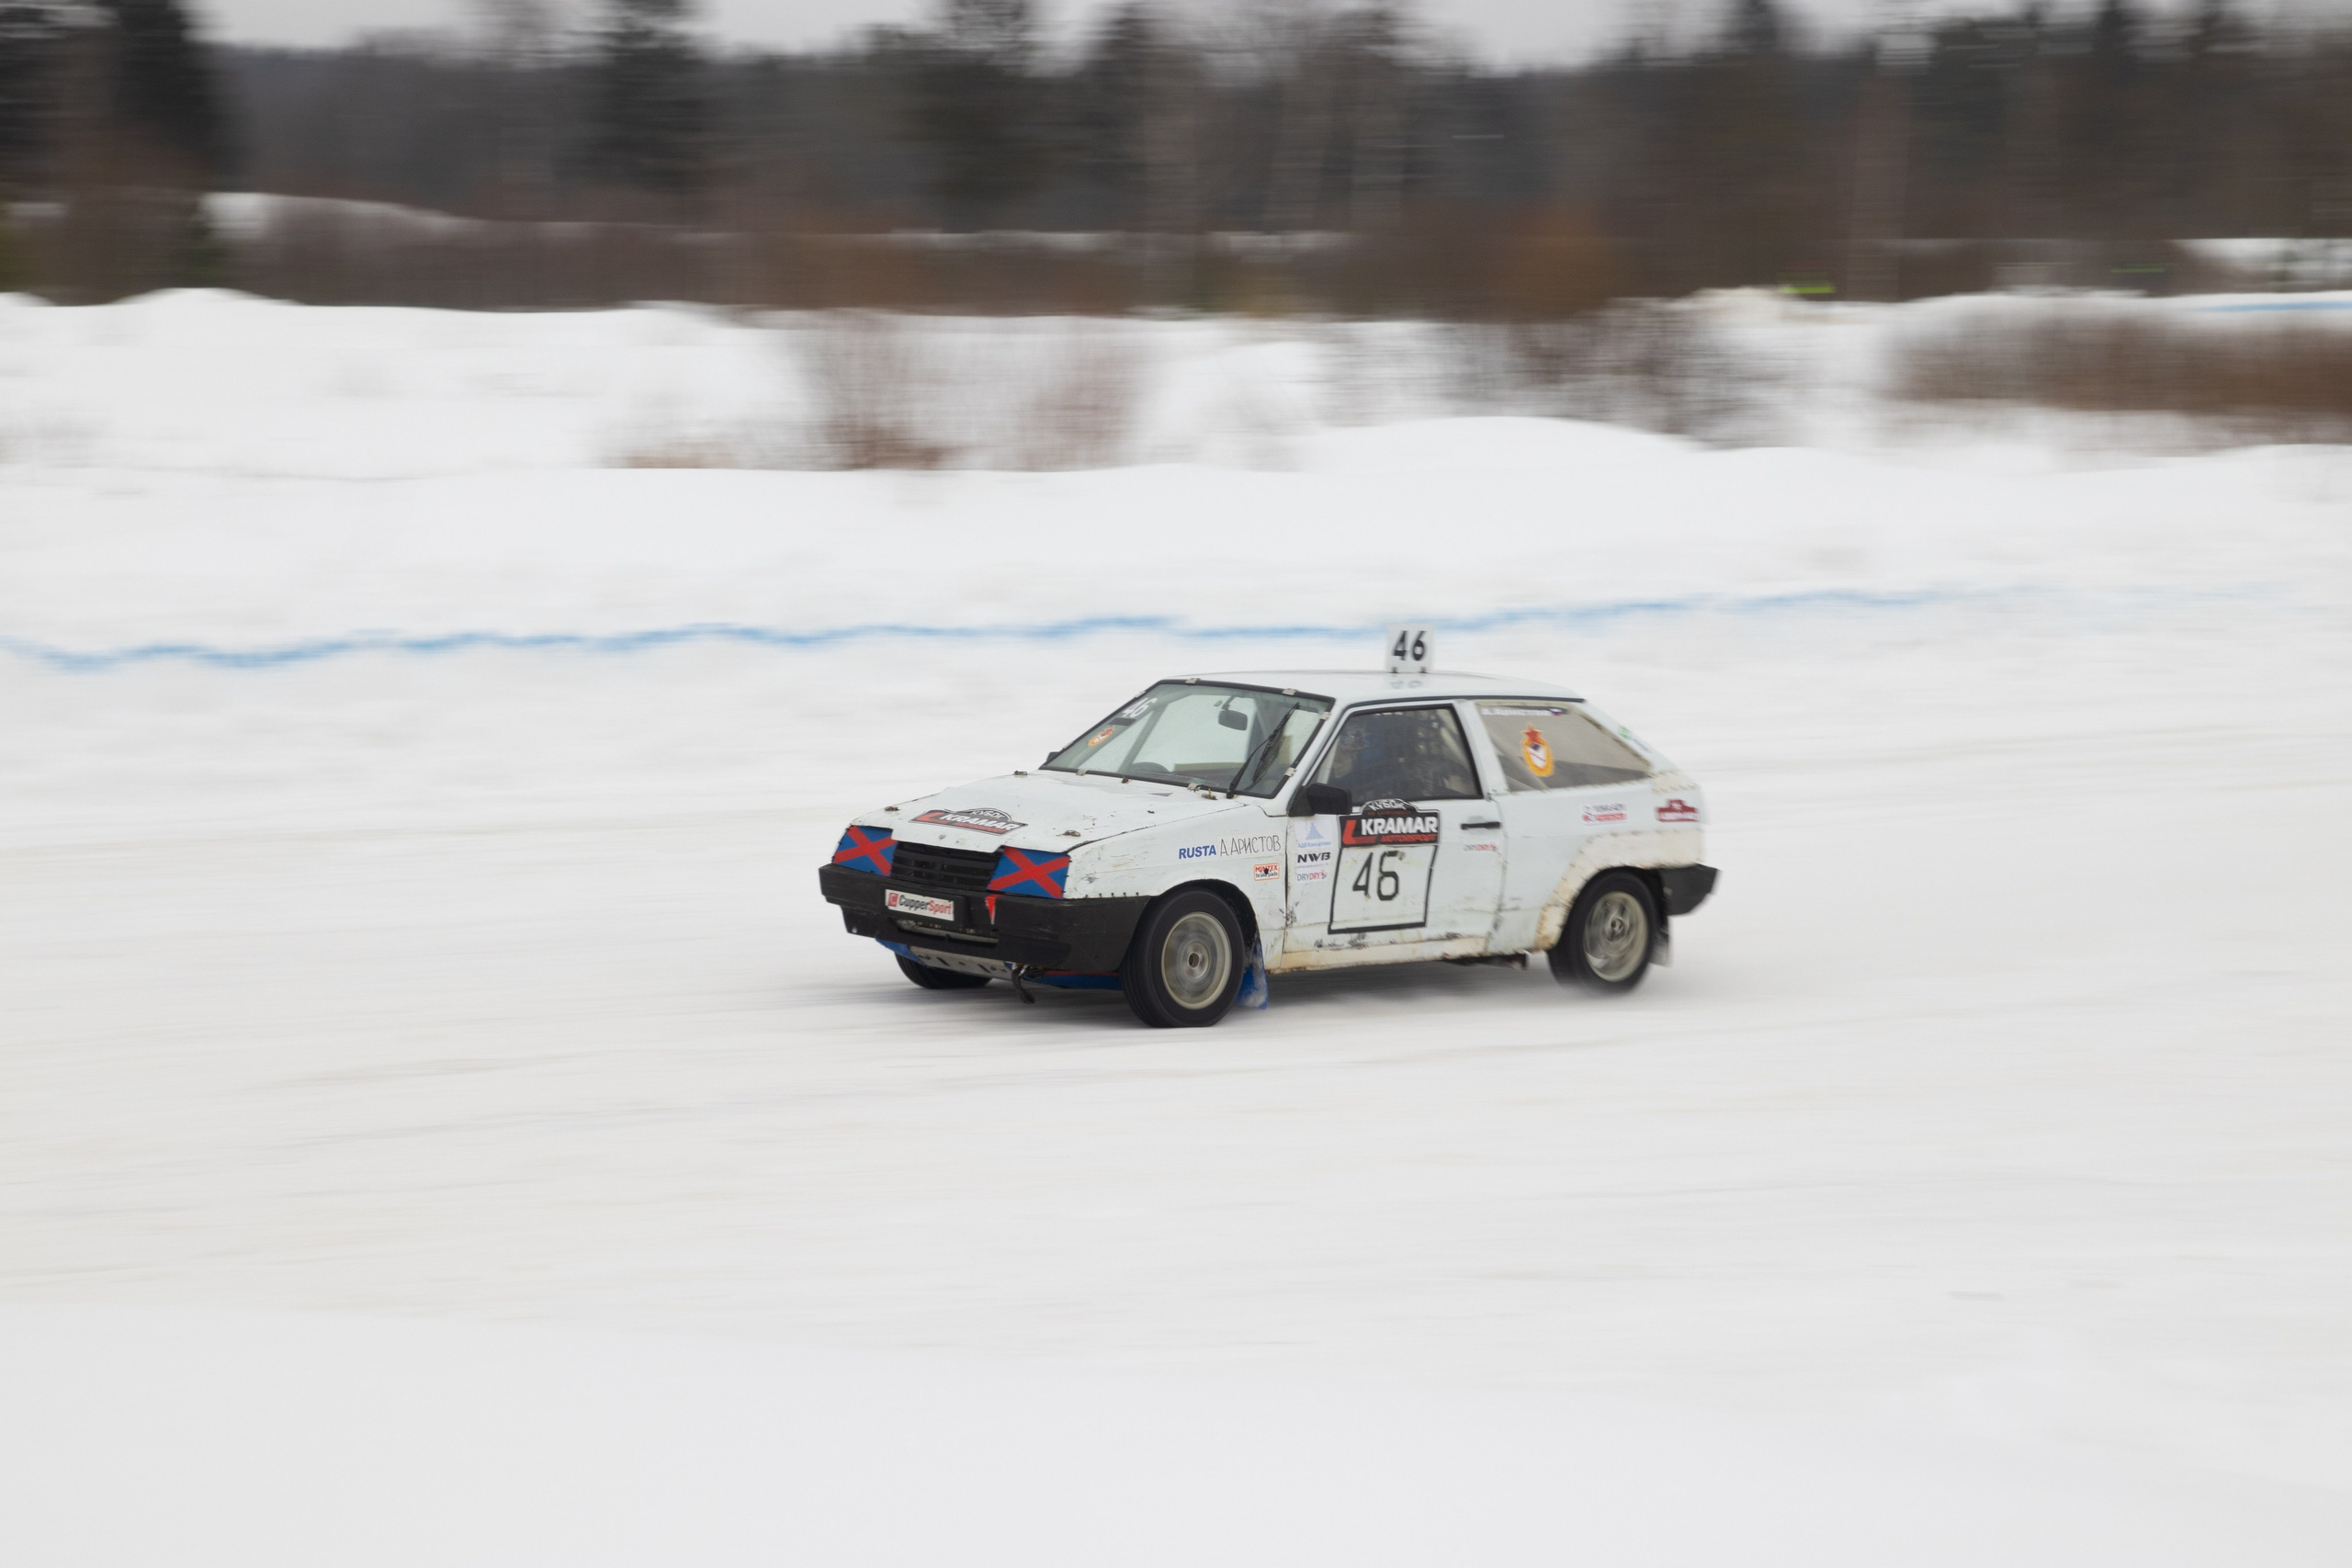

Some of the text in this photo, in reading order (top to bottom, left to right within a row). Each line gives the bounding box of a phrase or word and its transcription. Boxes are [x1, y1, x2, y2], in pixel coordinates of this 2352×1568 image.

[1391, 629, 1428, 661] 46
[1122, 697, 1158, 718] 46
[939, 814, 1020, 831] KRAMAR
[1361, 816, 1439, 836] KRAMAR
[1178, 844, 1217, 860] RUSTA
[1296, 852, 1331, 863] NWB
[1352, 851, 1407, 902] 46
